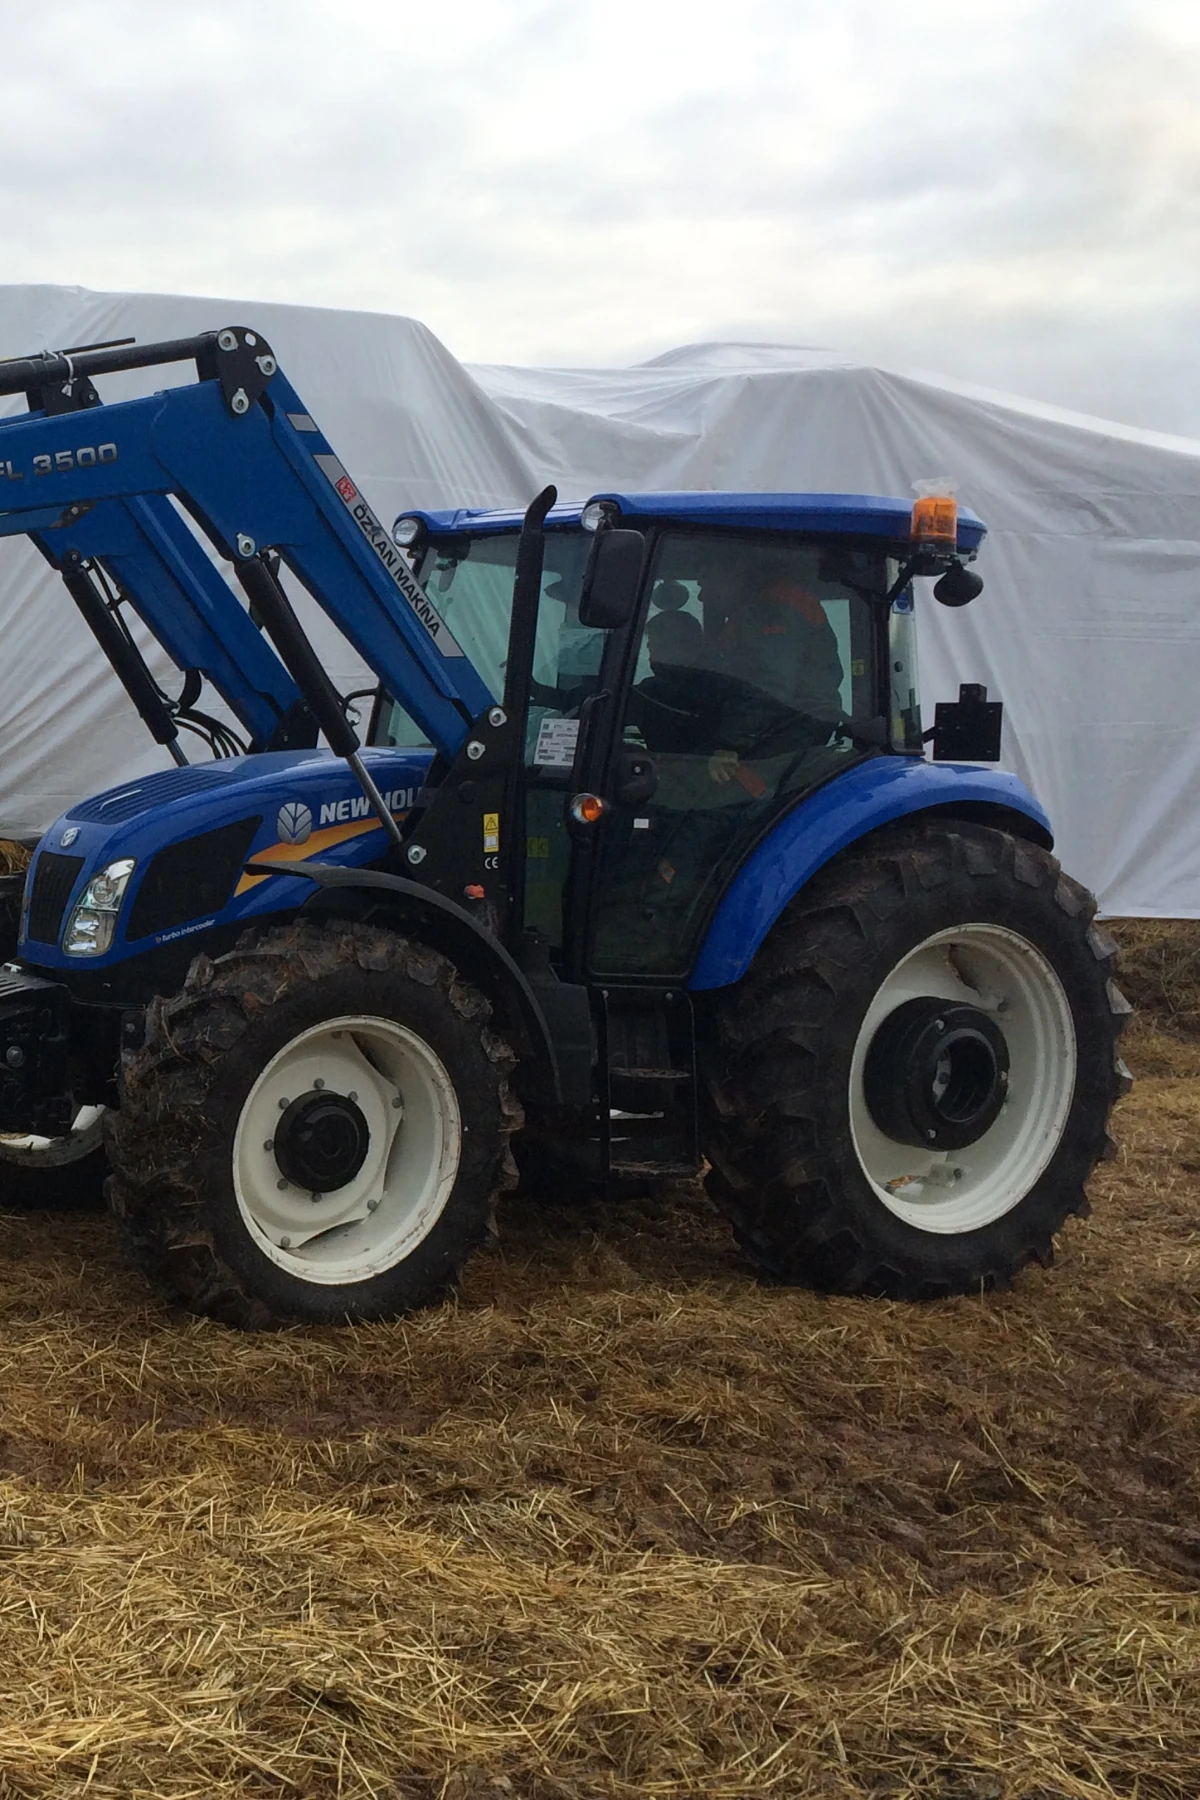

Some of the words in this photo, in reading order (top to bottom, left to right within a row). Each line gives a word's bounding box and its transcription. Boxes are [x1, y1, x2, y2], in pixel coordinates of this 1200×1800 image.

[32, 442, 118, 477] 3500
[353, 503, 398, 569] ÖZKAN
[393, 566, 441, 638] MAKİNA
[319, 795, 371, 825] NEW
[484, 856, 499, 870] CE
[162, 930, 181, 942] turbo
